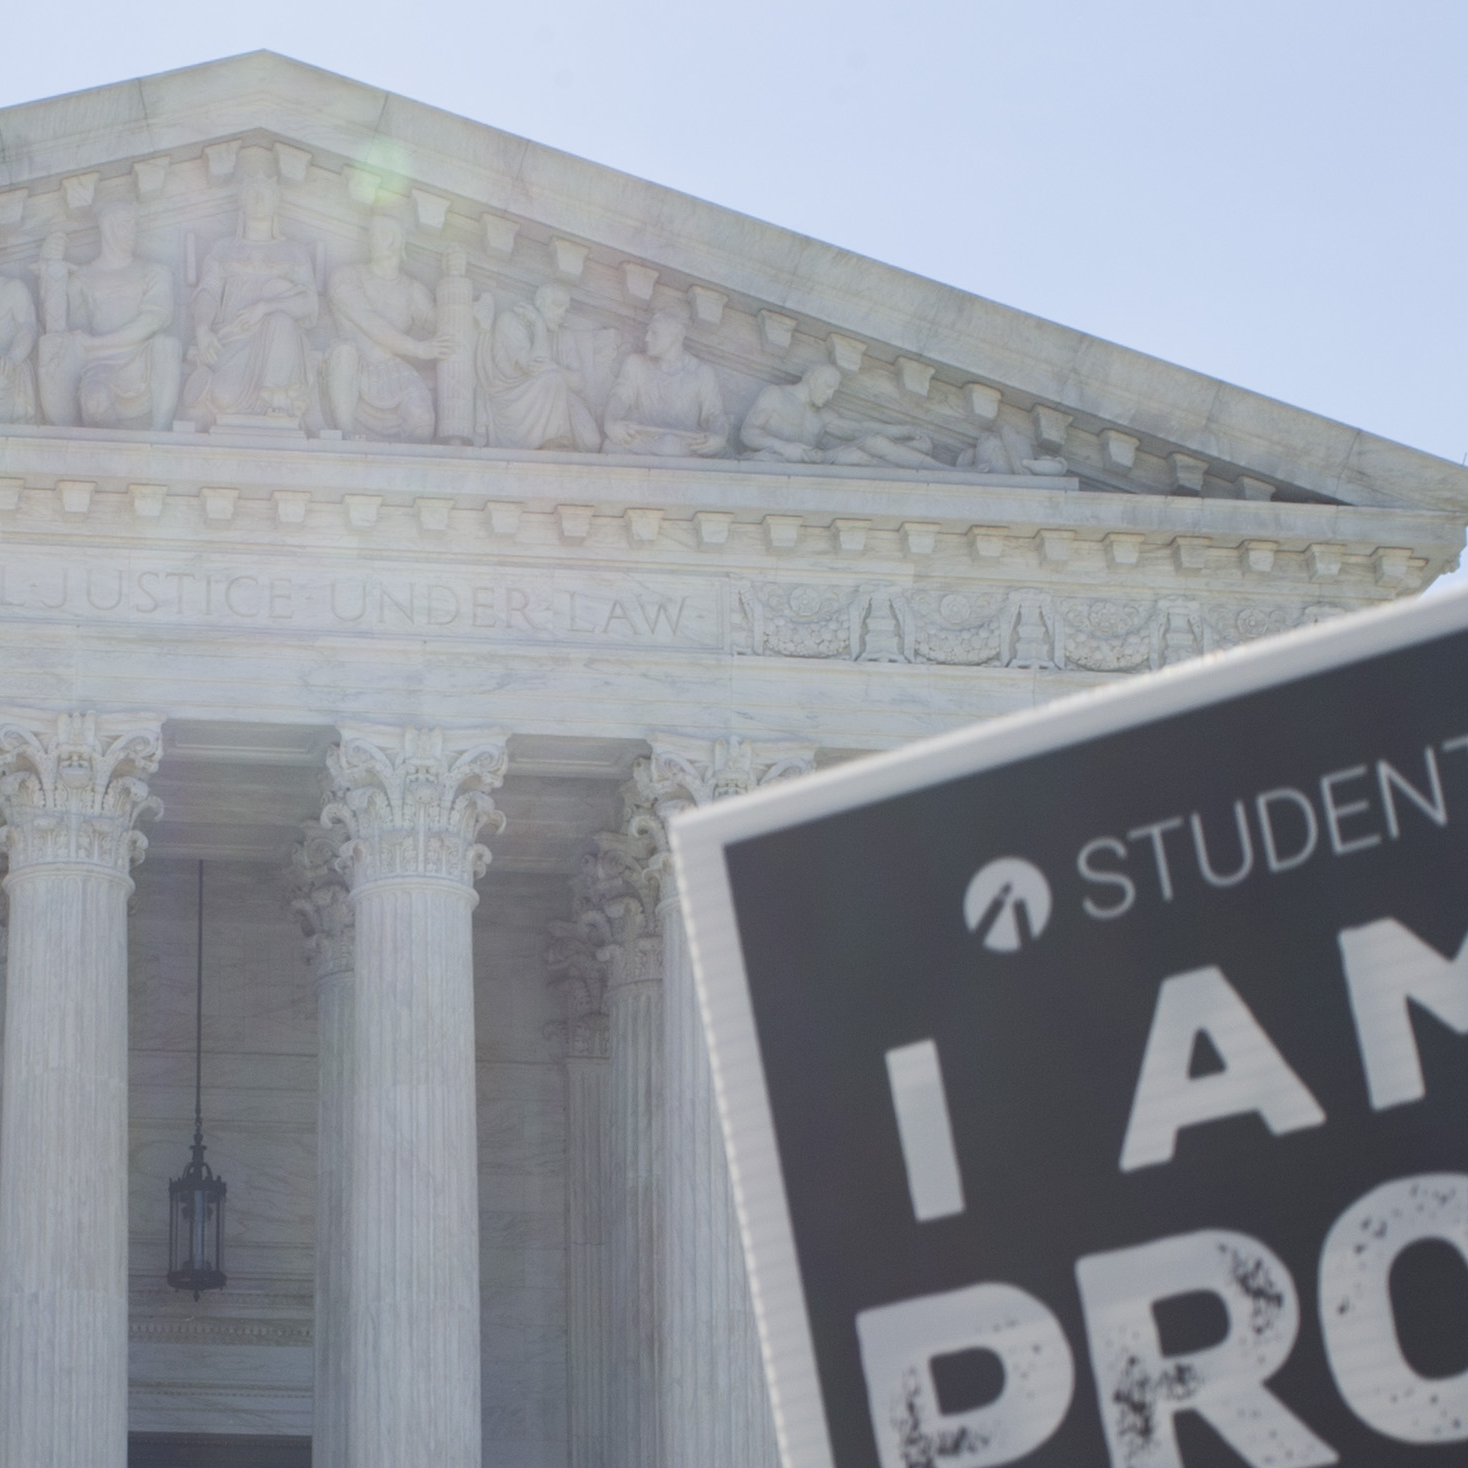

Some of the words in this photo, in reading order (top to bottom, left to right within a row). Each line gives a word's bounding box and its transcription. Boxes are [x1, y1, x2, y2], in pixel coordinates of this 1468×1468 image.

[39, 566, 296, 619] JUSTICE
[329, 576, 537, 629] UNDER
[566, 590, 691, 637] LAW
[885, 1040, 964, 1221] I
